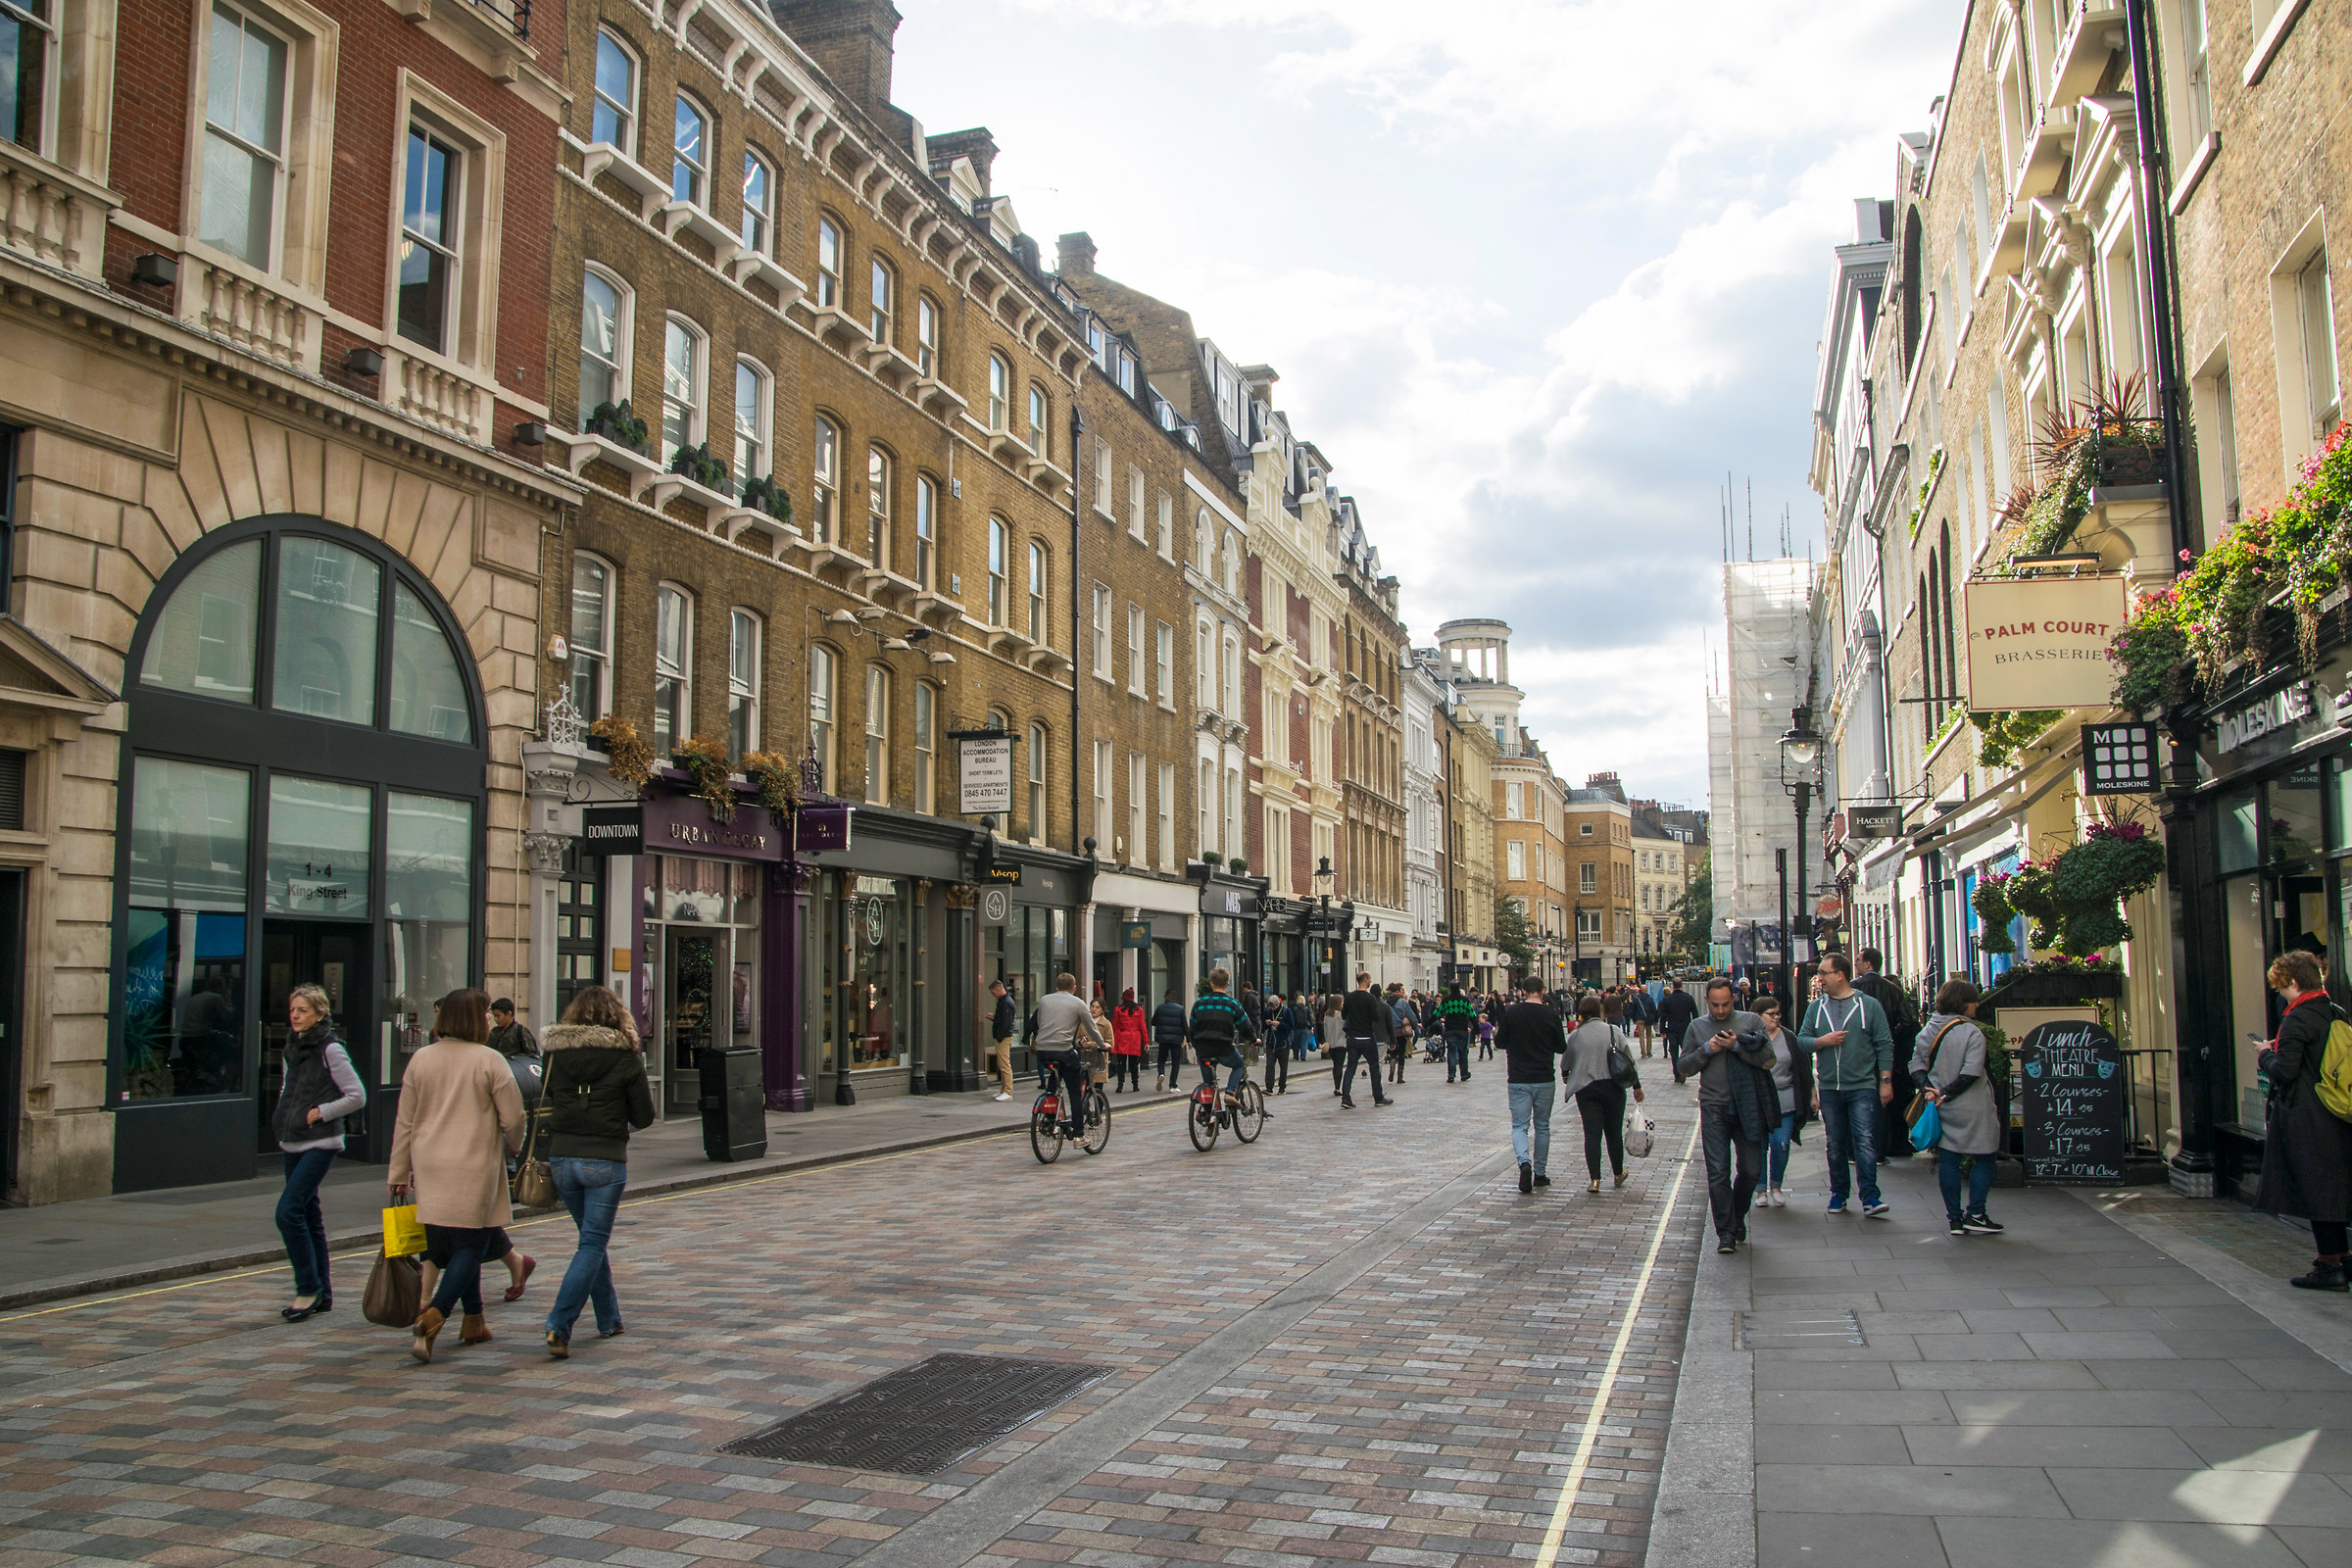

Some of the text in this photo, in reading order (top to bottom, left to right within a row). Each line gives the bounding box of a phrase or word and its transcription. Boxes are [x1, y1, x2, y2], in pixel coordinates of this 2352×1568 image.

[1984, 620, 2110, 640] PALM COURT
[1994, 649, 2103, 664] BRASSERIE
[2218, 679, 2311, 755] MOLESKINE
[2092, 730, 2111, 744] M
[2096, 780, 2150, 789] MOLESKINE
[964, 789, 979, 798] 0845
[1856, 816, 1895, 825] HACKETT
[588, 824, 638, 839] DOWNTOWN
[670, 823, 766, 850] URBAN DECAY
[305, 862, 312, 876] 1
[324, 863, 332, 877] 4
[287, 884, 348, 900] King Street
[2034, 1025, 2109, 1049] Lunch
[2040, 1049, 2099, 1064] THEATRE
[2051, 1063, 2084, 1077] MENU
[2039, 1082, 2049, 1098] 2
[2043, 1121, 2055, 1137] 3
